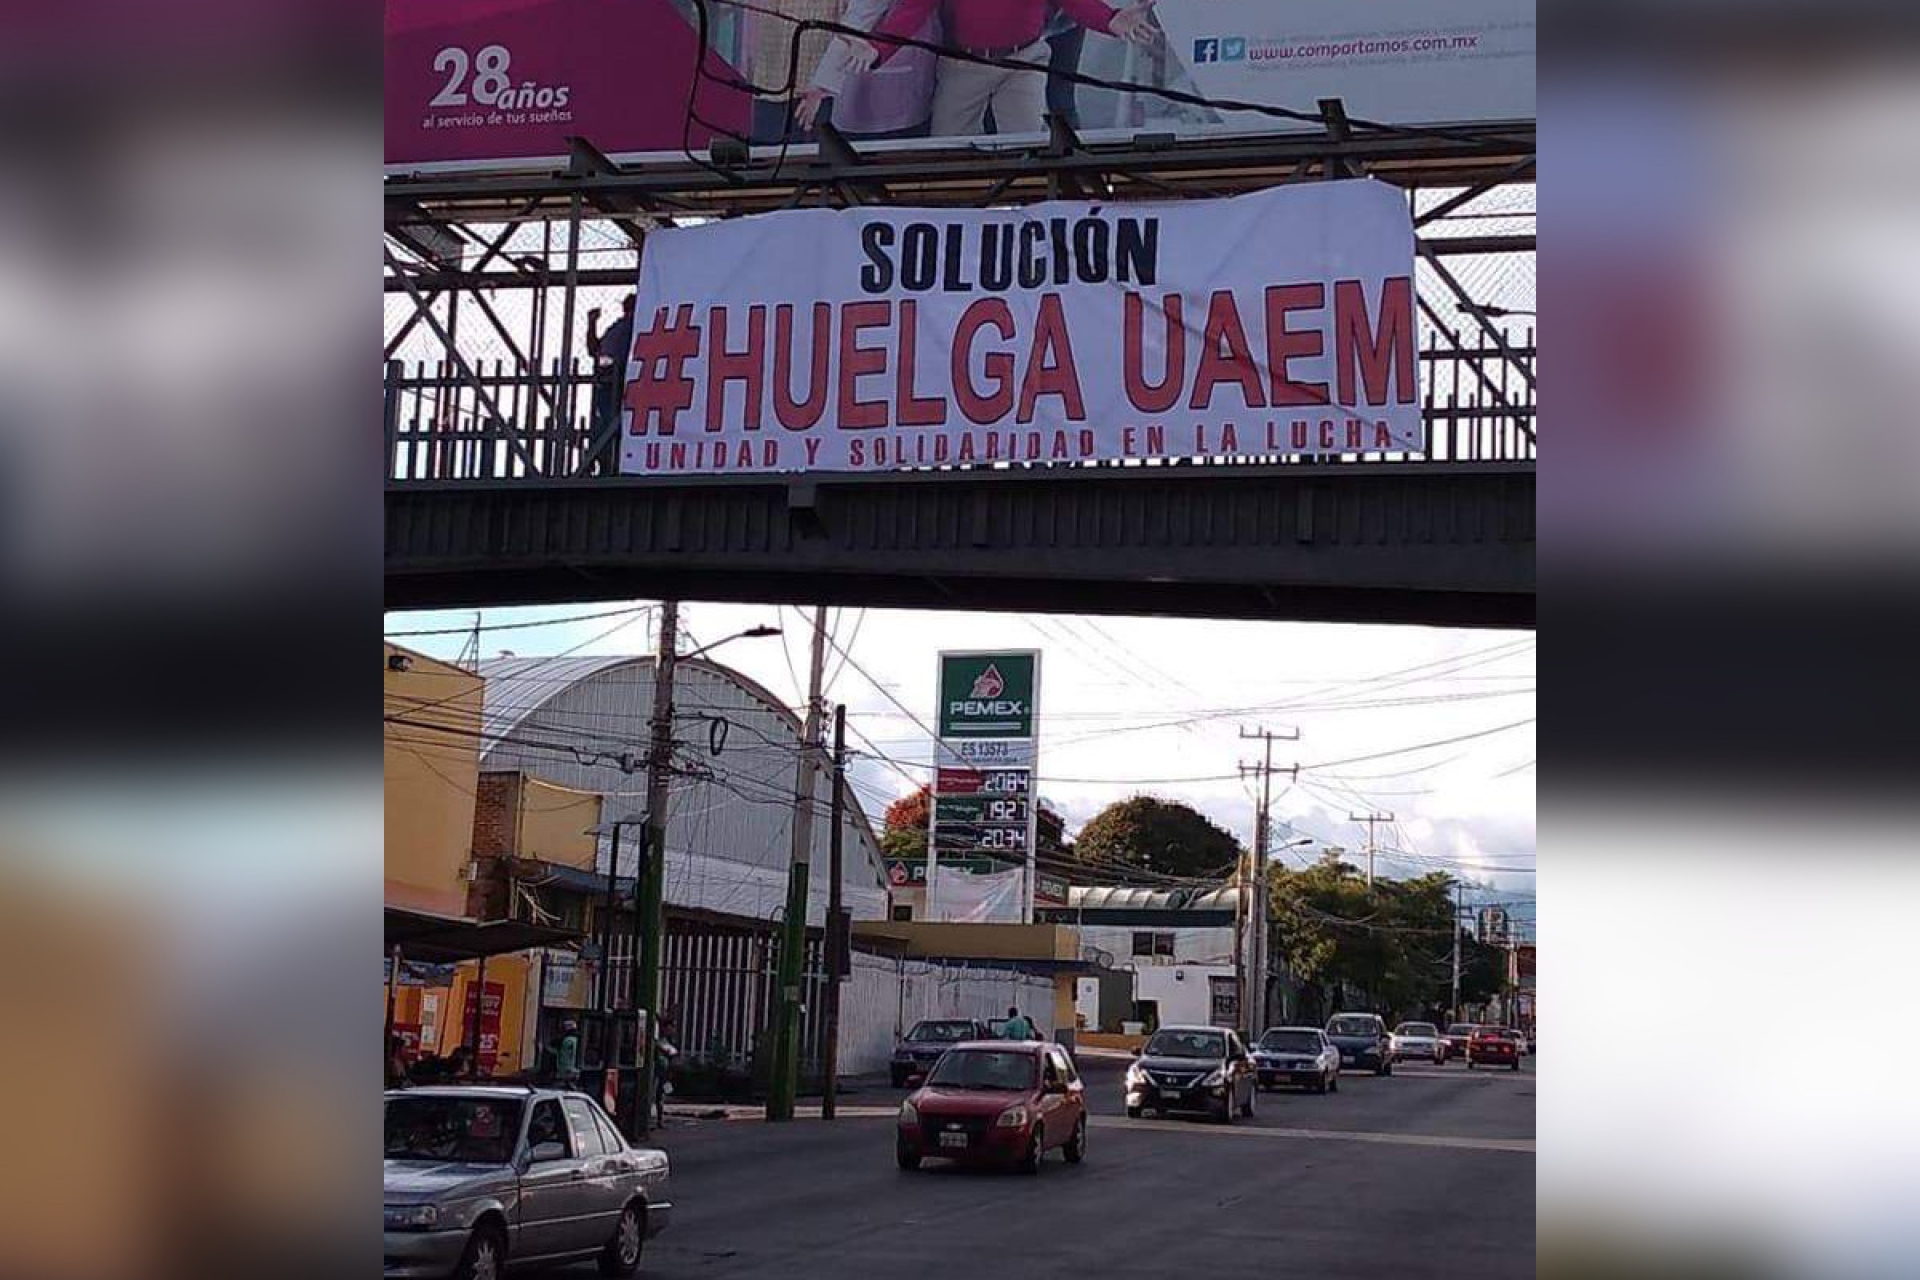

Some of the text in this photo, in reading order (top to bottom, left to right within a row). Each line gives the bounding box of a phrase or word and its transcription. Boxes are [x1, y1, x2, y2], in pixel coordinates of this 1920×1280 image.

[1249, 36, 1478, 60] www.compartamos.com.mx
[429, 45, 511, 107] 28
[497, 81, 569, 109] años
[423, 108, 573, 128] al servicio de tus sueños
[860, 206, 1158, 293] SOLUCIÓN
[624, 277, 1416, 436] #HUELGA UAEM
[645, 440, 779, 470] UNIDAD
[805, 438, 822, 466] Y
[849, 430, 1095, 466] SOLIDARIDAD
[1122, 426, 1164, 455] EN
[1195, 424, 1238, 453] LA
[950, 701, 1023, 716] PEMEX
